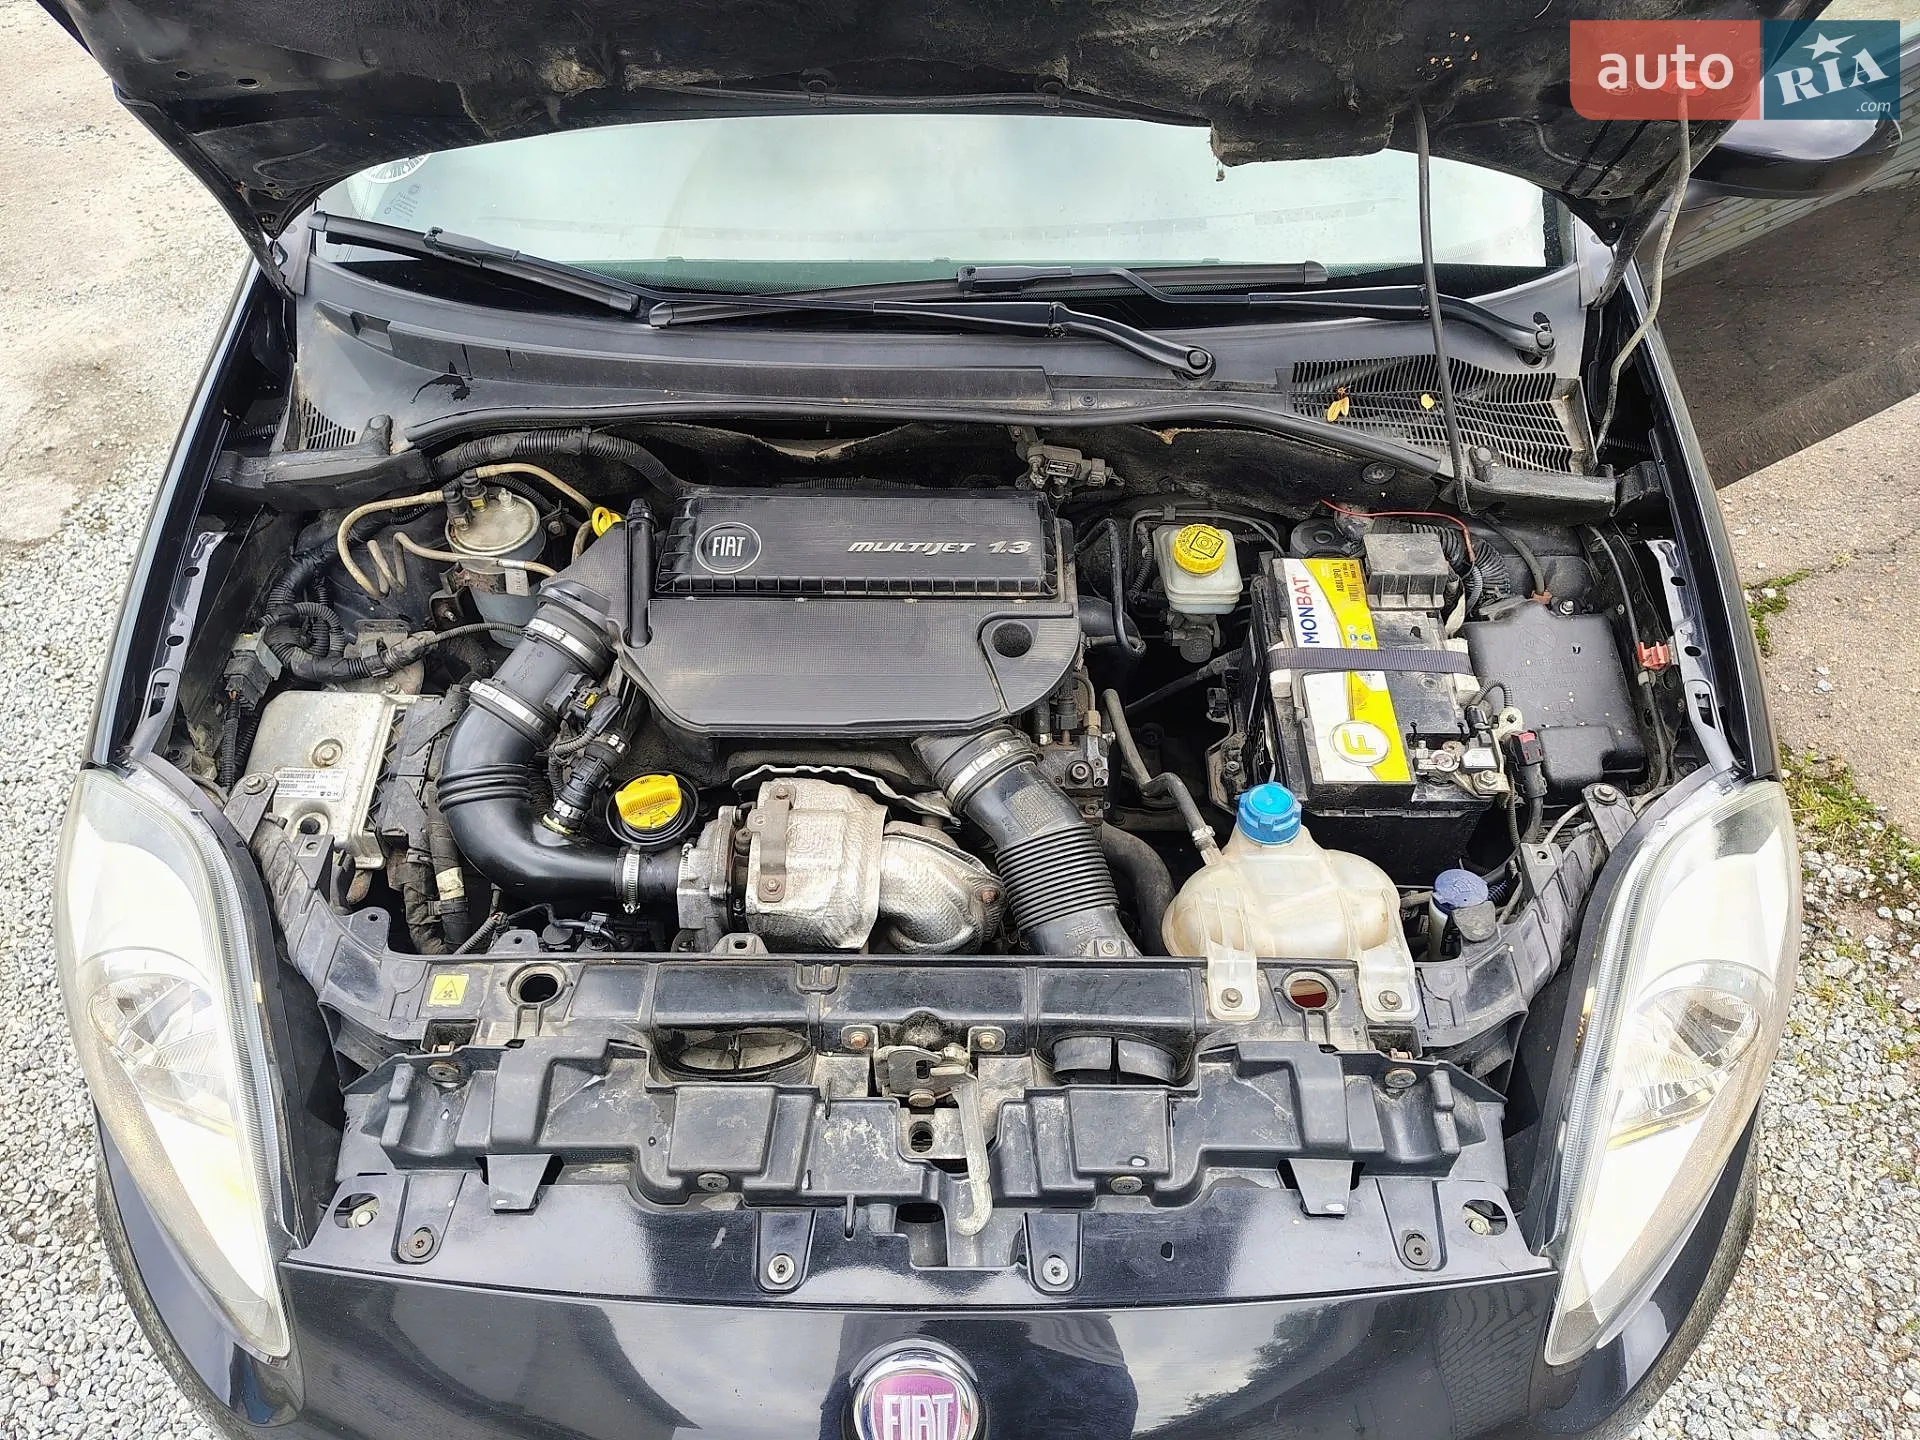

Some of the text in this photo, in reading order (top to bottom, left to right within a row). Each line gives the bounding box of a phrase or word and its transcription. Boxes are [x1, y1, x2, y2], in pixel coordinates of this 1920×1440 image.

[711, 536, 746, 557] FIAT
[847, 540, 1033, 556] MULTIJET 1.3
[1292, 577, 1320, 644] MONBAT
[1341, 730, 1377, 756] F
[882, 1393, 955, 1440] FIAT
